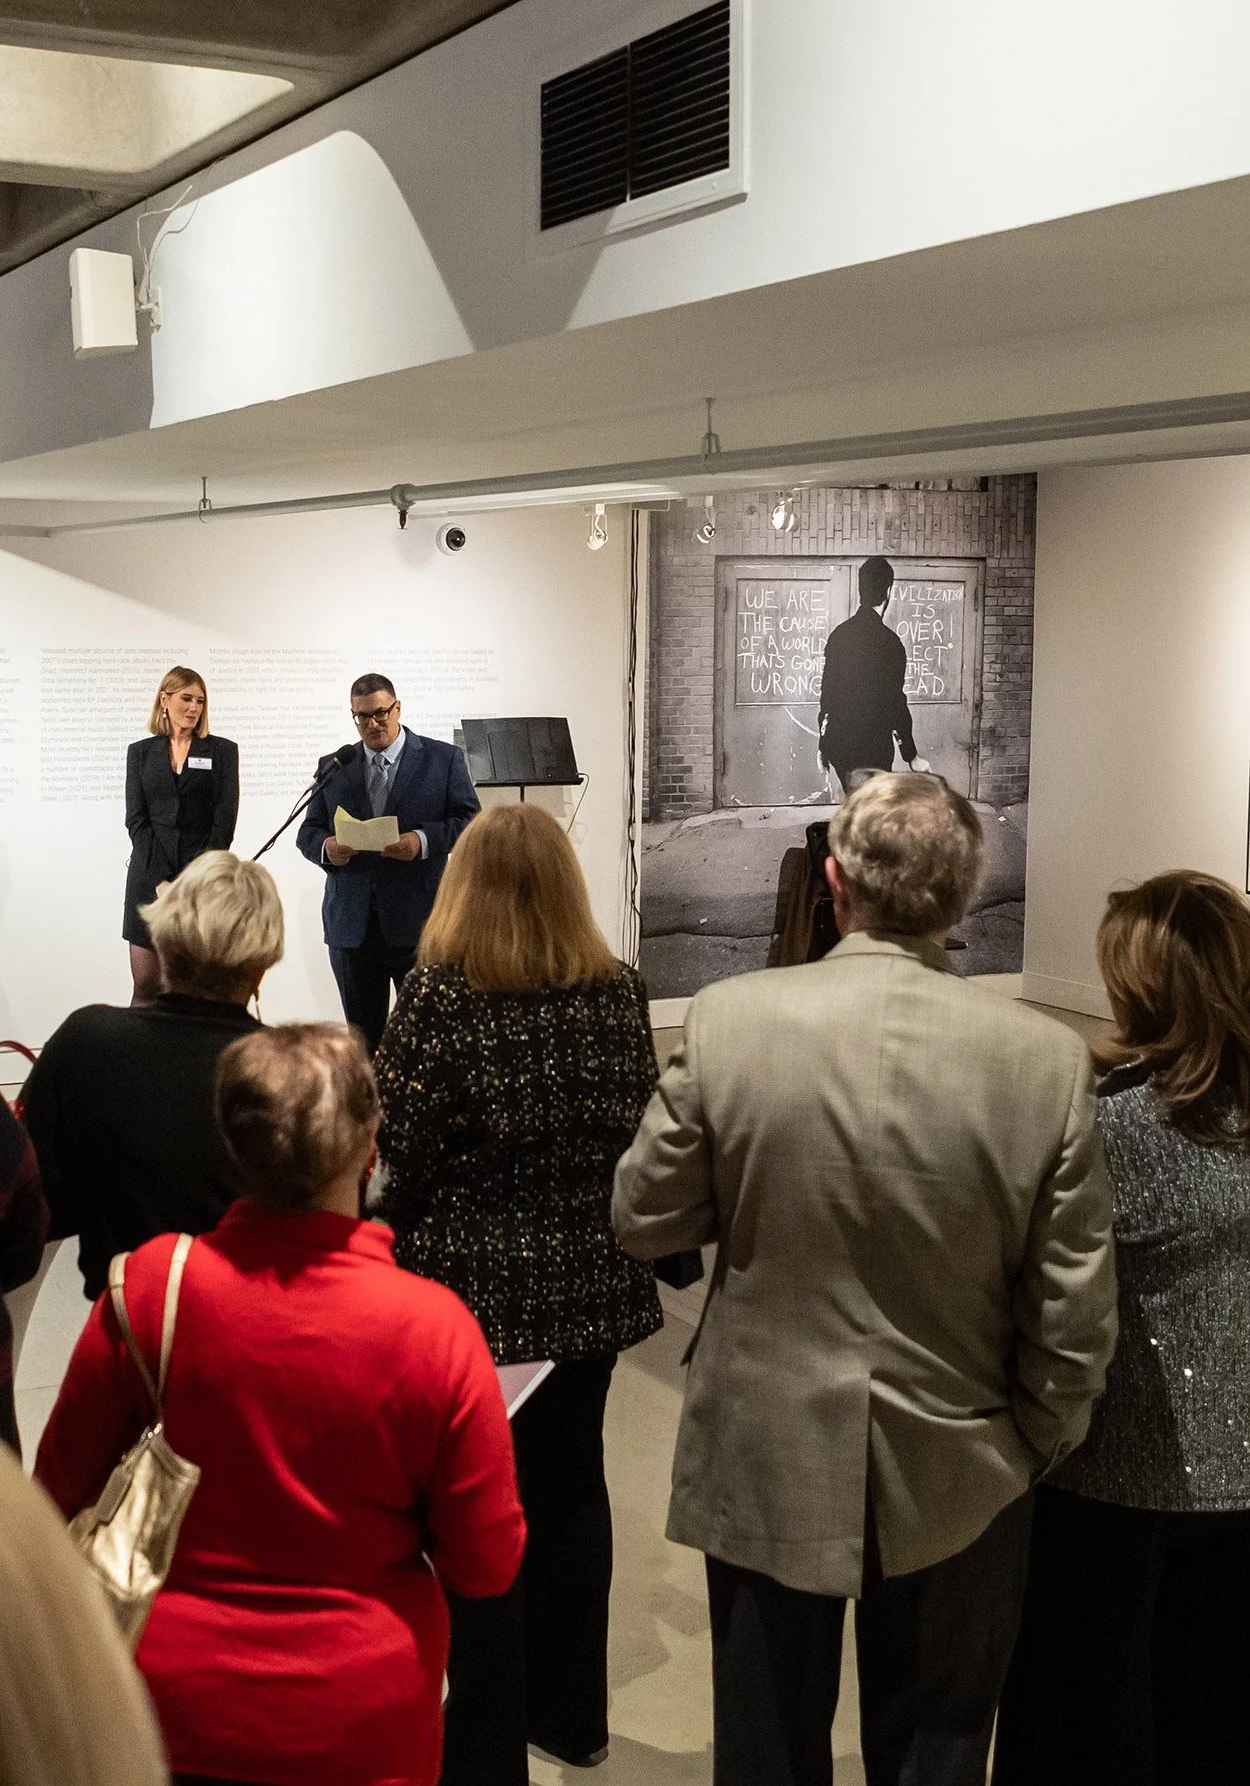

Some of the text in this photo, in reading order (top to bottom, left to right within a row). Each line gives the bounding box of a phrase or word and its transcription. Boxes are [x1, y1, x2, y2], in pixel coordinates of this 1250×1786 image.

[745, 587, 826, 612] WE ARE
[890, 585, 964, 602] IVILIZATION
[911, 602, 935, 618] IS
[738, 612, 774, 635] THE
[740, 634, 827, 655] OF A WORLD
[791, 655, 826, 674] GONE
[906, 645, 948, 667] ECT
[906, 662, 934, 676] THE
[751, 672, 822, 696] WRONG
[903, 675, 945, 696] EAD
